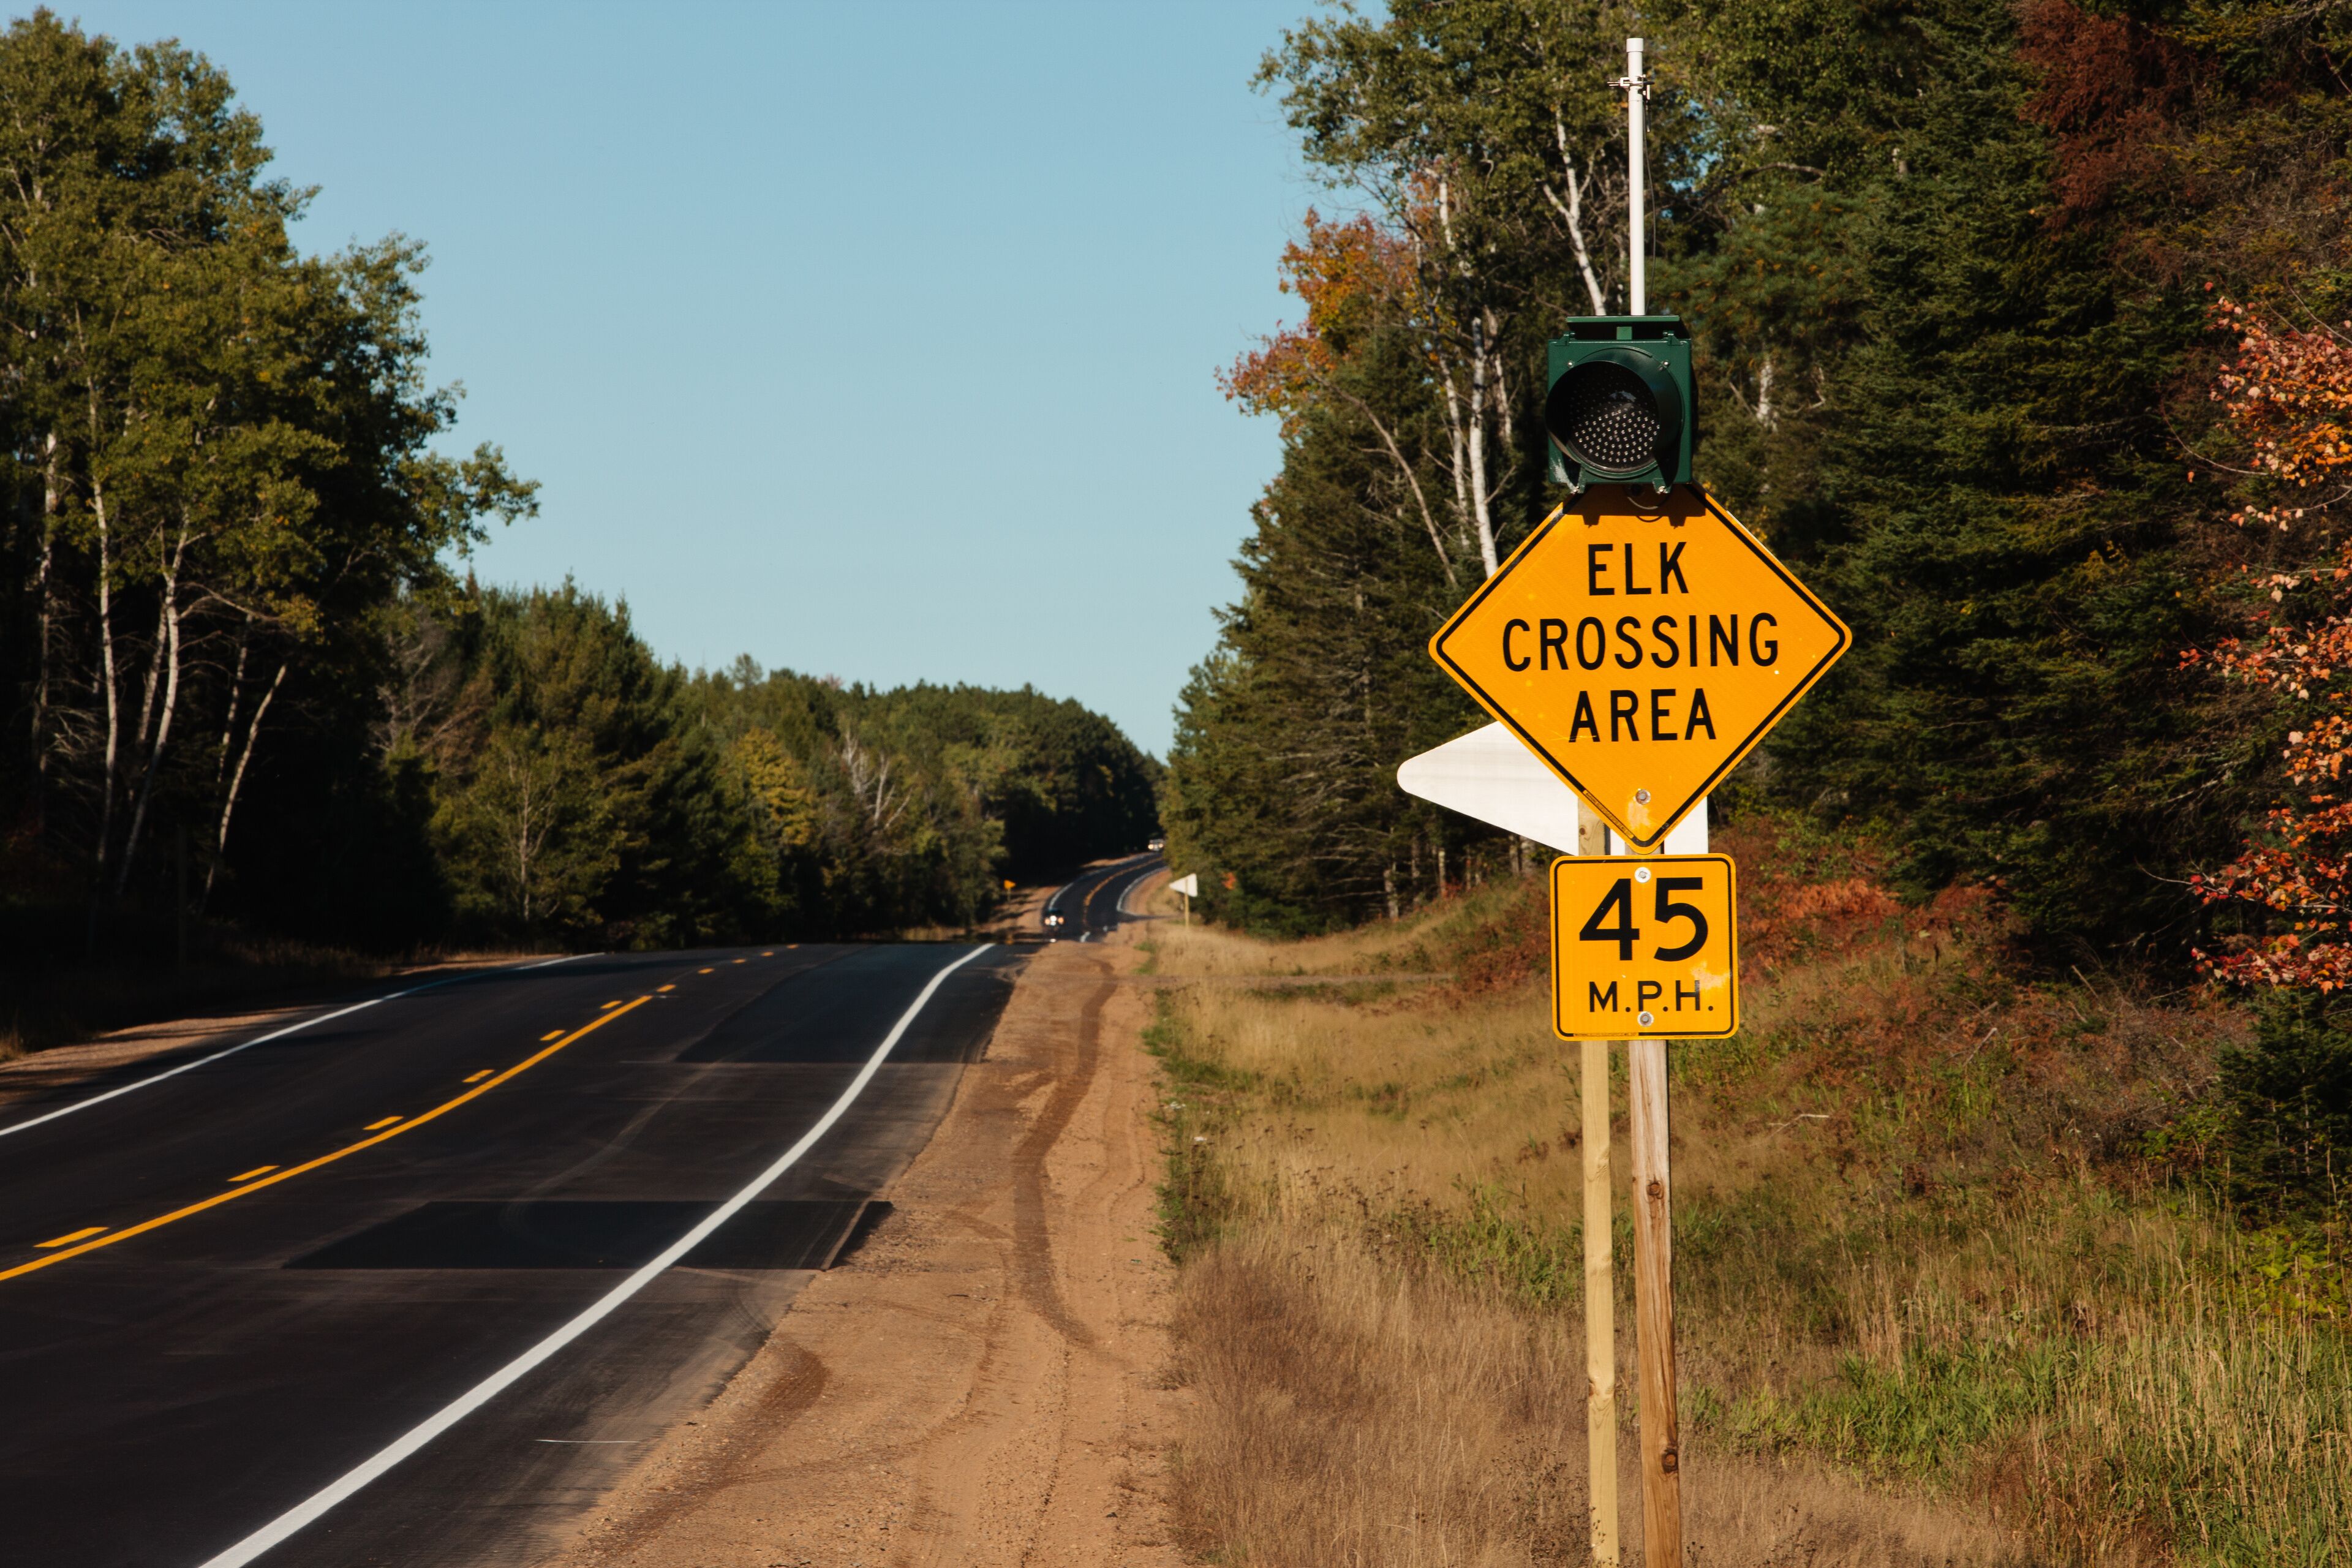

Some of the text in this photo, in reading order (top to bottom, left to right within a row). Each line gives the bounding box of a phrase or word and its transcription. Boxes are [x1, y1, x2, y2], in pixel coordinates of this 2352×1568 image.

[1588, 541, 1689, 596] ELK
[1502, 612, 1779, 672] CROSSING
[1569, 688, 1717, 743] AREA
[1579, 876, 1709, 962] 45
[1589, 980, 1714, 1012] M.P.H.
